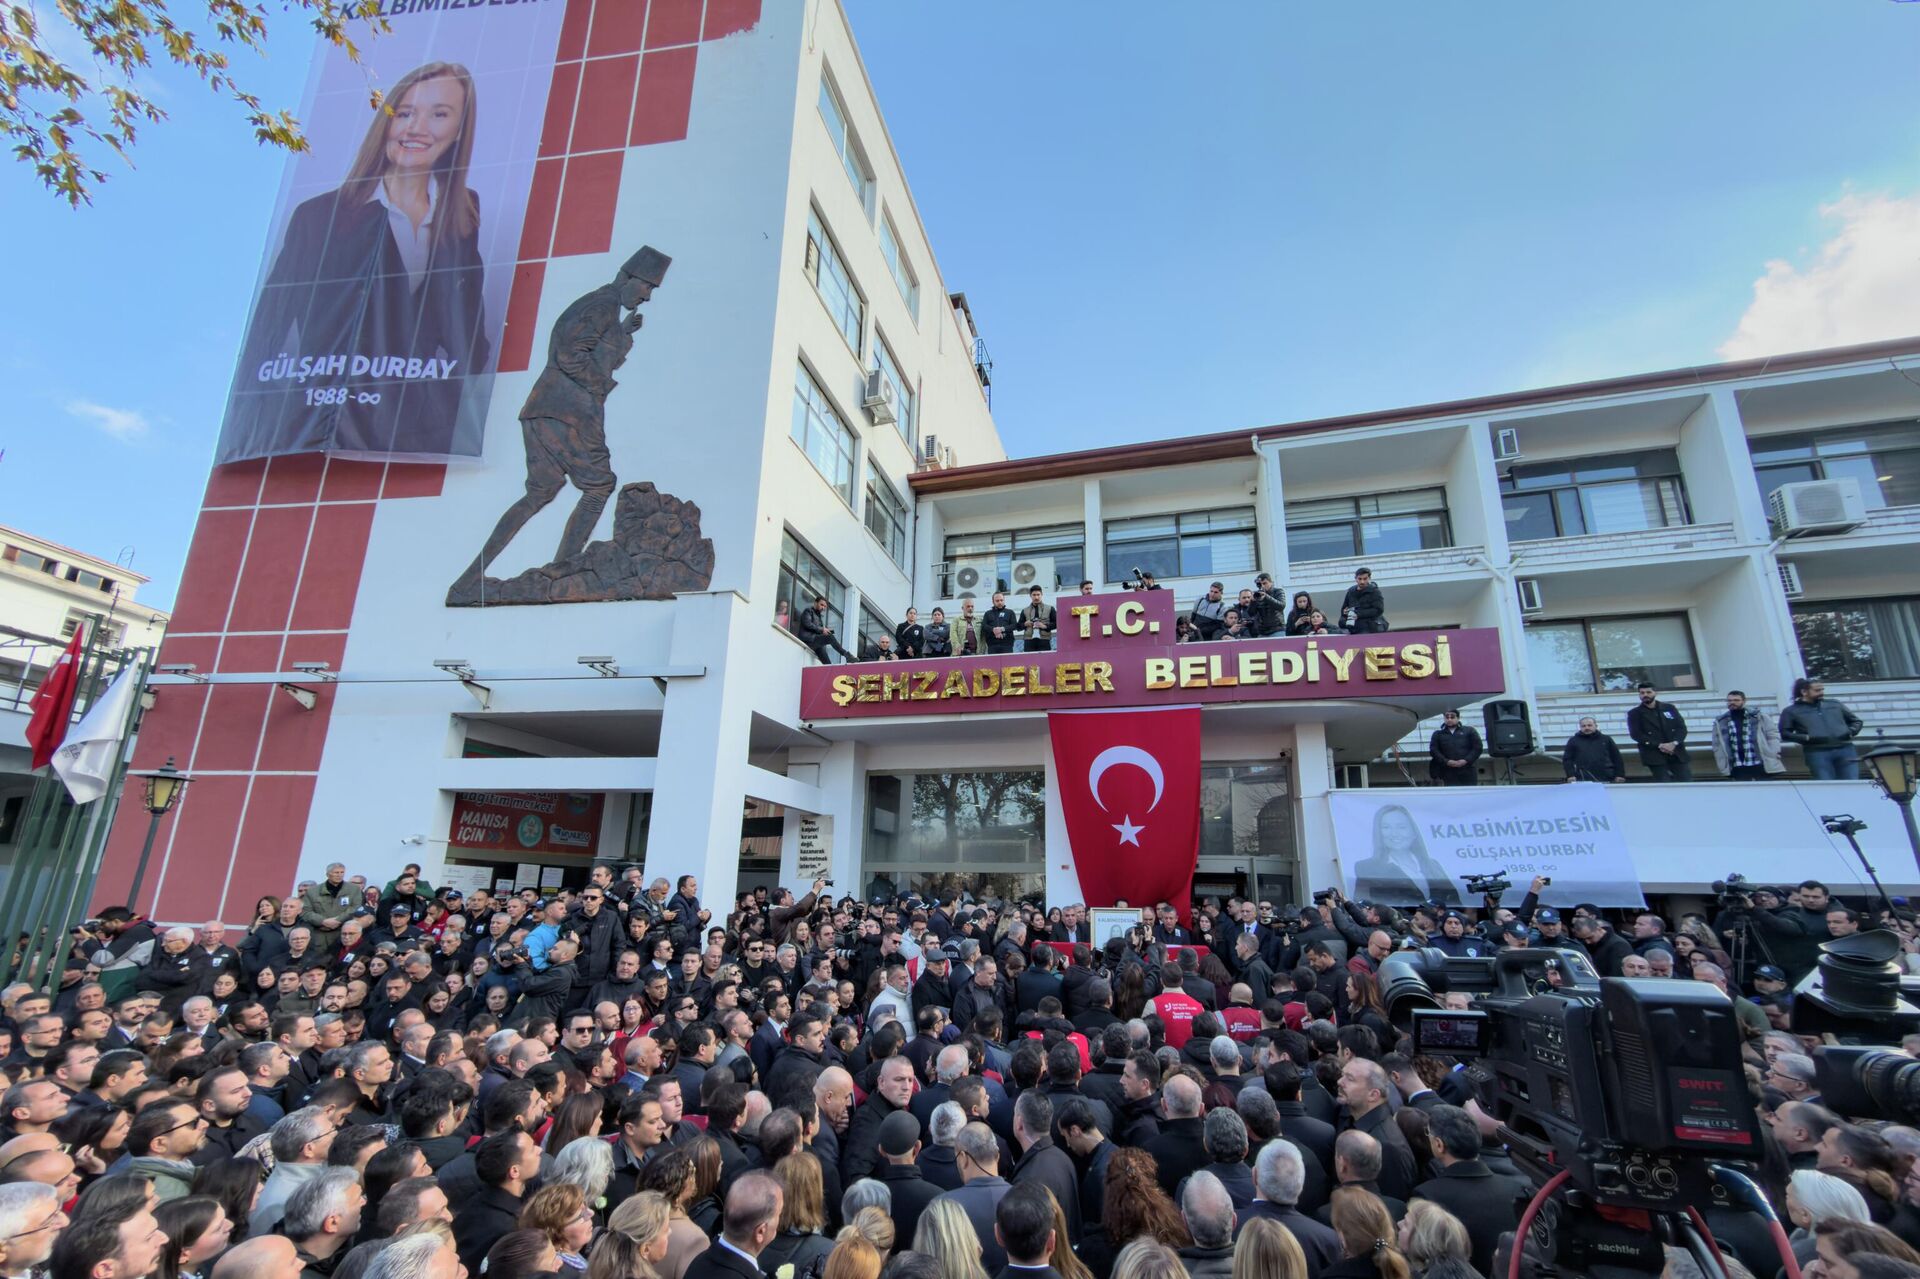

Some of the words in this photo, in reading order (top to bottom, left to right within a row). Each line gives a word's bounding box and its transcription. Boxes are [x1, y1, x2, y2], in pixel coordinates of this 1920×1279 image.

[258, 353, 347, 383] GÜLŞAH
[351, 354, 458, 380] DURBAY
[1071, 601, 1160, 639] T.C.
[831, 661, 1116, 706] ŞEHZADELER
[1145, 635, 1453, 689] BELEDİYESİ
[459, 810, 509, 829] MANİSA
[1430, 811, 1611, 840] KALBİMİZDESİN
[457, 825, 486, 844] İÇİN
[1455, 844, 1524, 861] GÜLŞAH
[1526, 842, 1595, 858] DURBAY
[1597, 1243, 1640, 1256] sachtler
